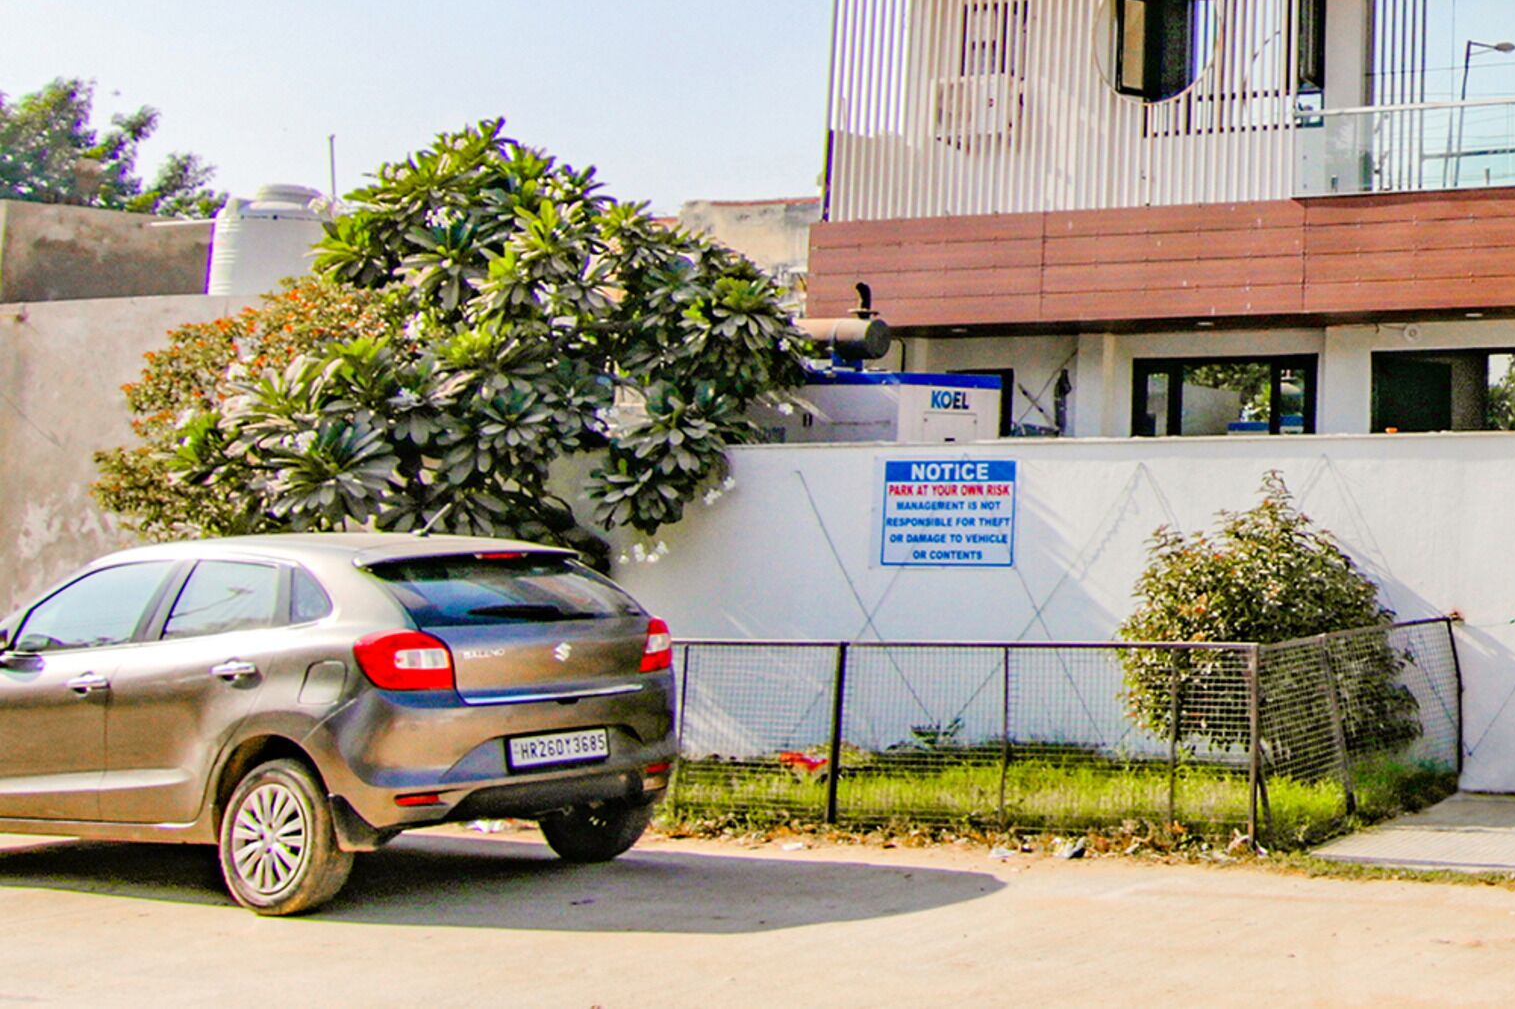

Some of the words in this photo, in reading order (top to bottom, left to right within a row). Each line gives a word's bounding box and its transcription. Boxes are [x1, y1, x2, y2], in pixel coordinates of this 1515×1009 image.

[930, 389, 970, 411] KOEL
[910, 463, 989, 480] NOTICE
[888, 484, 914, 496] PARK
[916, 484, 928, 496] AT
[931, 484, 958, 496] YOUR
[960, 484, 983, 496] OWN
[986, 484, 1010, 496] RISK
[896, 501, 965, 511] MANAGEMENT
[967, 501, 977, 511] IS
[980, 501, 1001, 511] NOT
[886, 517, 953, 527] RESPONSIBLE
[956, 517, 975, 527] FOR
[979, 517, 1010, 527] THEFT
[889, 534, 904, 544] OR
[906, 534, 946, 544] DAMAGE
[950, 534, 963, 544] TO
[965, 534, 1008, 544] VEHICLE
[912, 550, 927, 560] OR
[929, 550, 983, 560] CONTENTS
